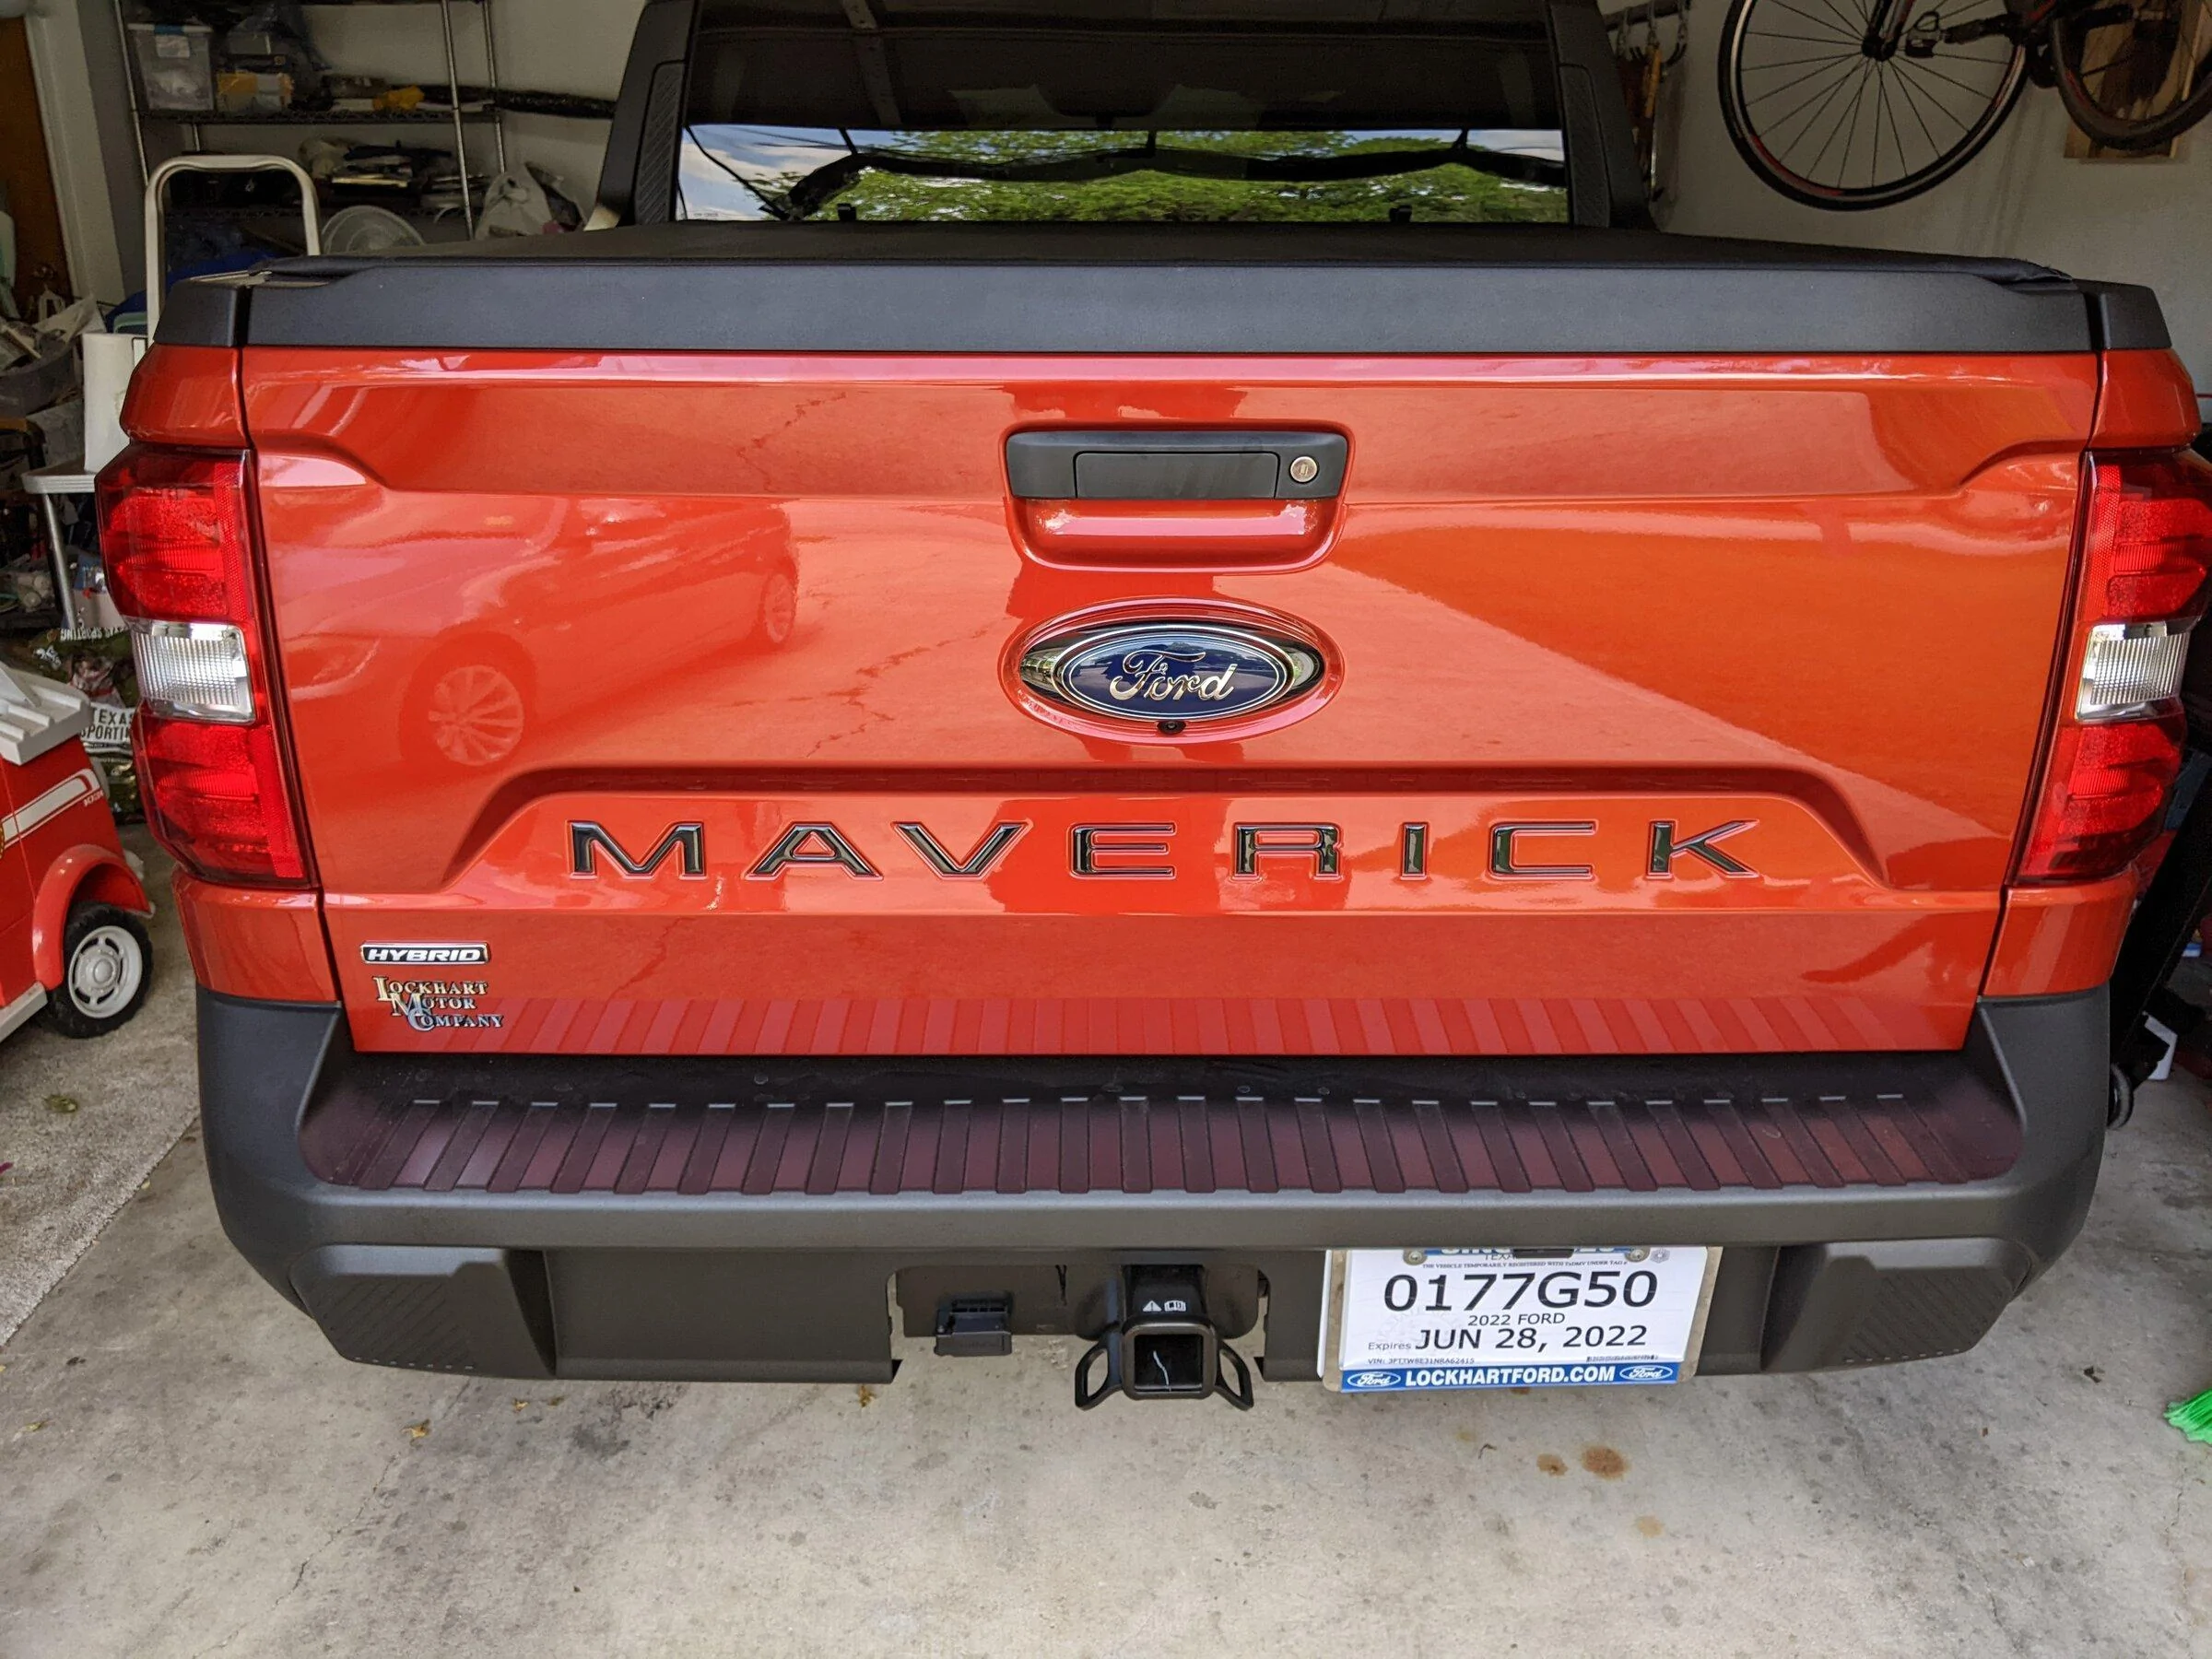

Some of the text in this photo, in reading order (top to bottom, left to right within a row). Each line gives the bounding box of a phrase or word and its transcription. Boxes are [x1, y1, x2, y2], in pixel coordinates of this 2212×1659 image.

[1110, 650, 1239, 700] Ford
[567, 820, 1758, 880] MAVERICK
[369, 949, 480, 961] HYBRID
[1383, 1270, 1658, 1312] 0177G50
[1467, 1312, 1566, 1326] 2022 FORD
[1368, 1325, 1647, 1353] Expires JUN 28, 2022
[1358, 1366, 1662, 1386] Ford LOCKHARTFORD.COM Ford
